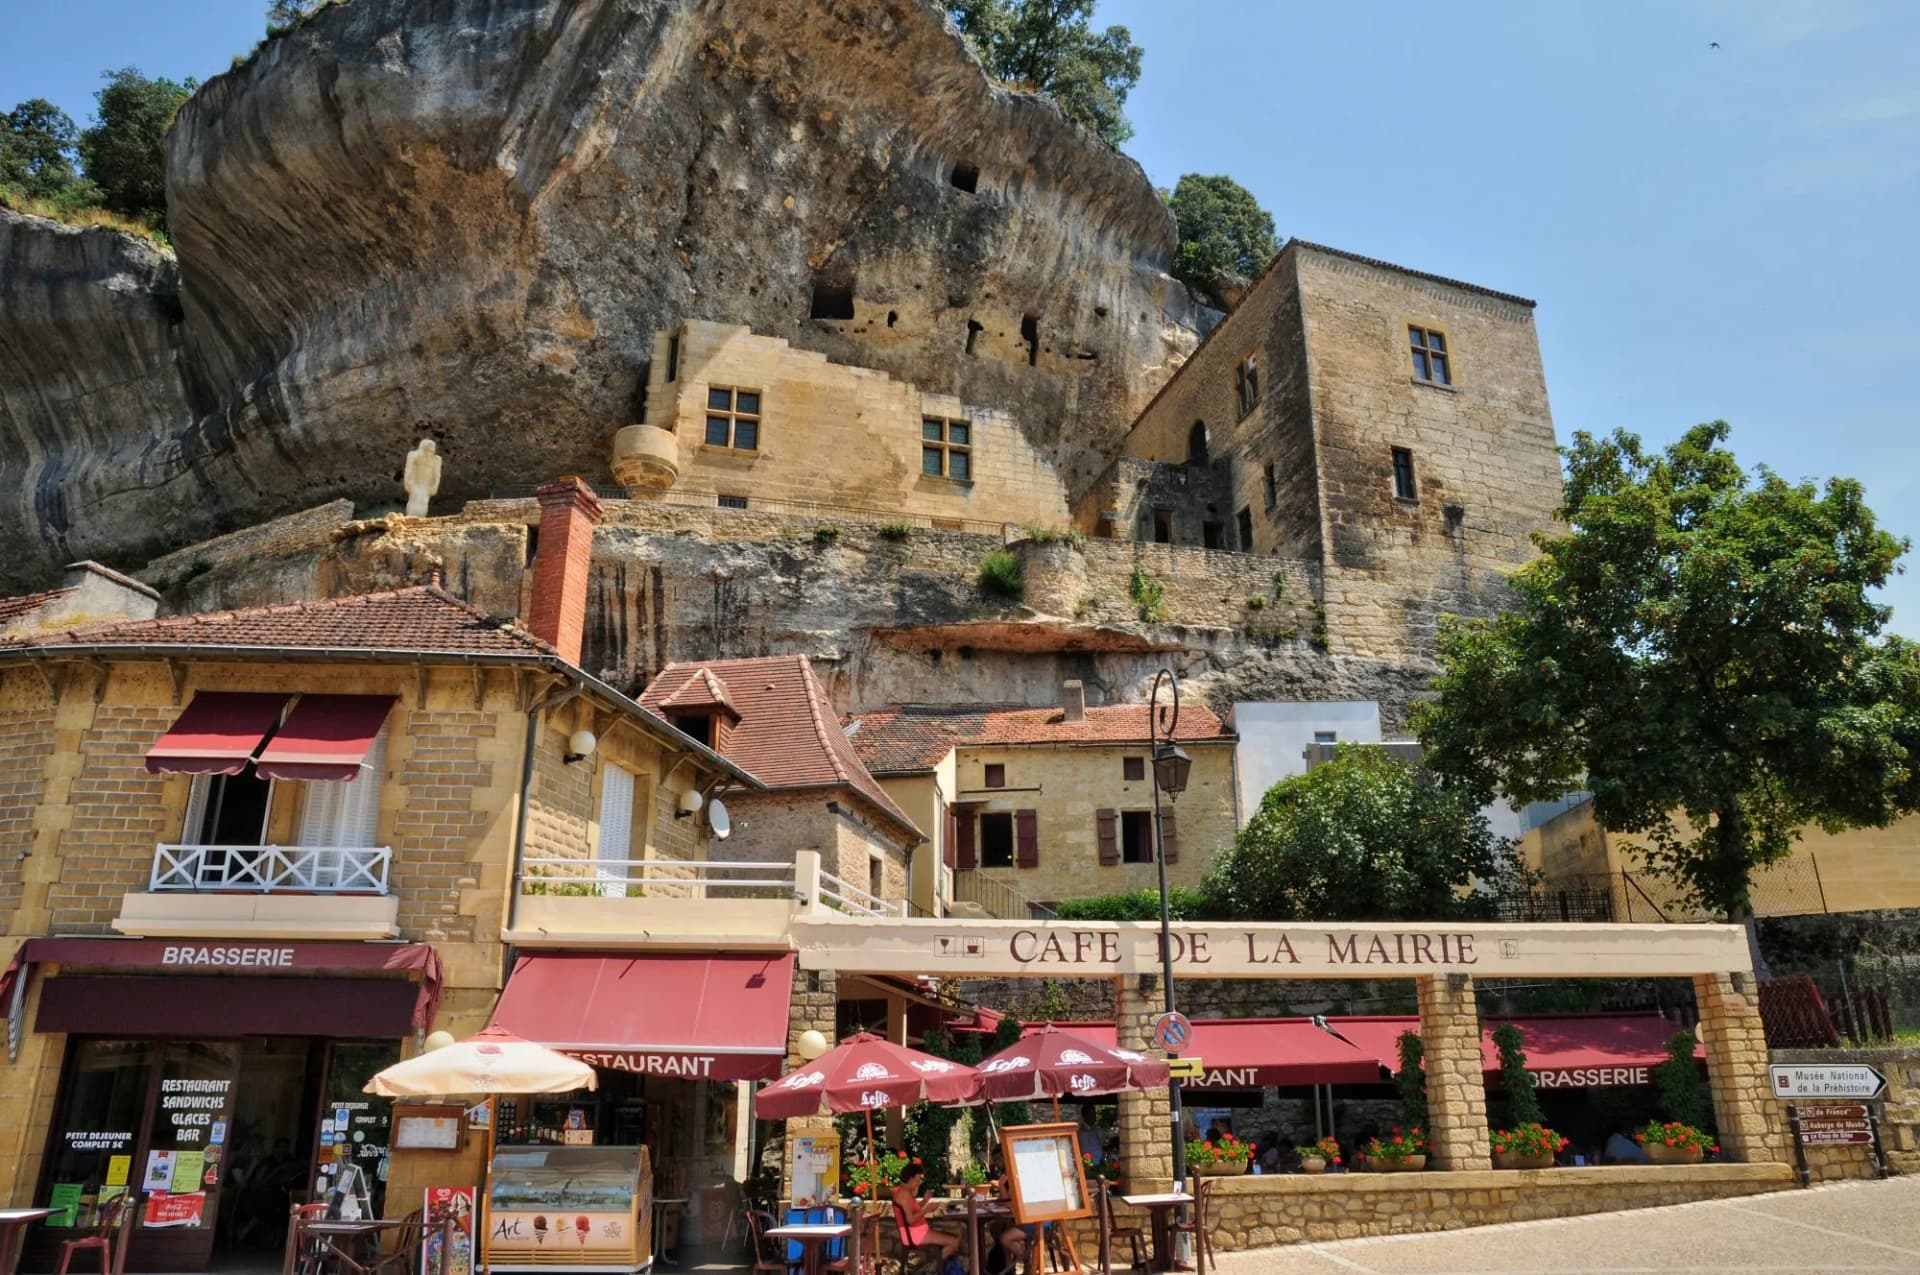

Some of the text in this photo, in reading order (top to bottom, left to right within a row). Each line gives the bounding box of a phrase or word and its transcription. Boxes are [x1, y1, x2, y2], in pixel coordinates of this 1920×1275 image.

[1009, 930, 1479, 965] CAFE DE LA MAIRIE
[162, 946, 295, 966] BRASSERIE
[1795, 1071, 1868, 1080] Musée National
[162, 1079, 231, 1093] RESTAURANT
[1797, 1083, 1870, 1092] de la Préhistoire
[162, 1096, 224, 1109] SANDWICHS
[171, 1113, 212, 1126] GLACES
[66, 1132, 132, 1140] PETIT DEJEUNER
[176, 1129, 200, 1142] BAR
[71, 1141, 110, 1149] COMPLET
[491, 1217, 522, 1240] Art
